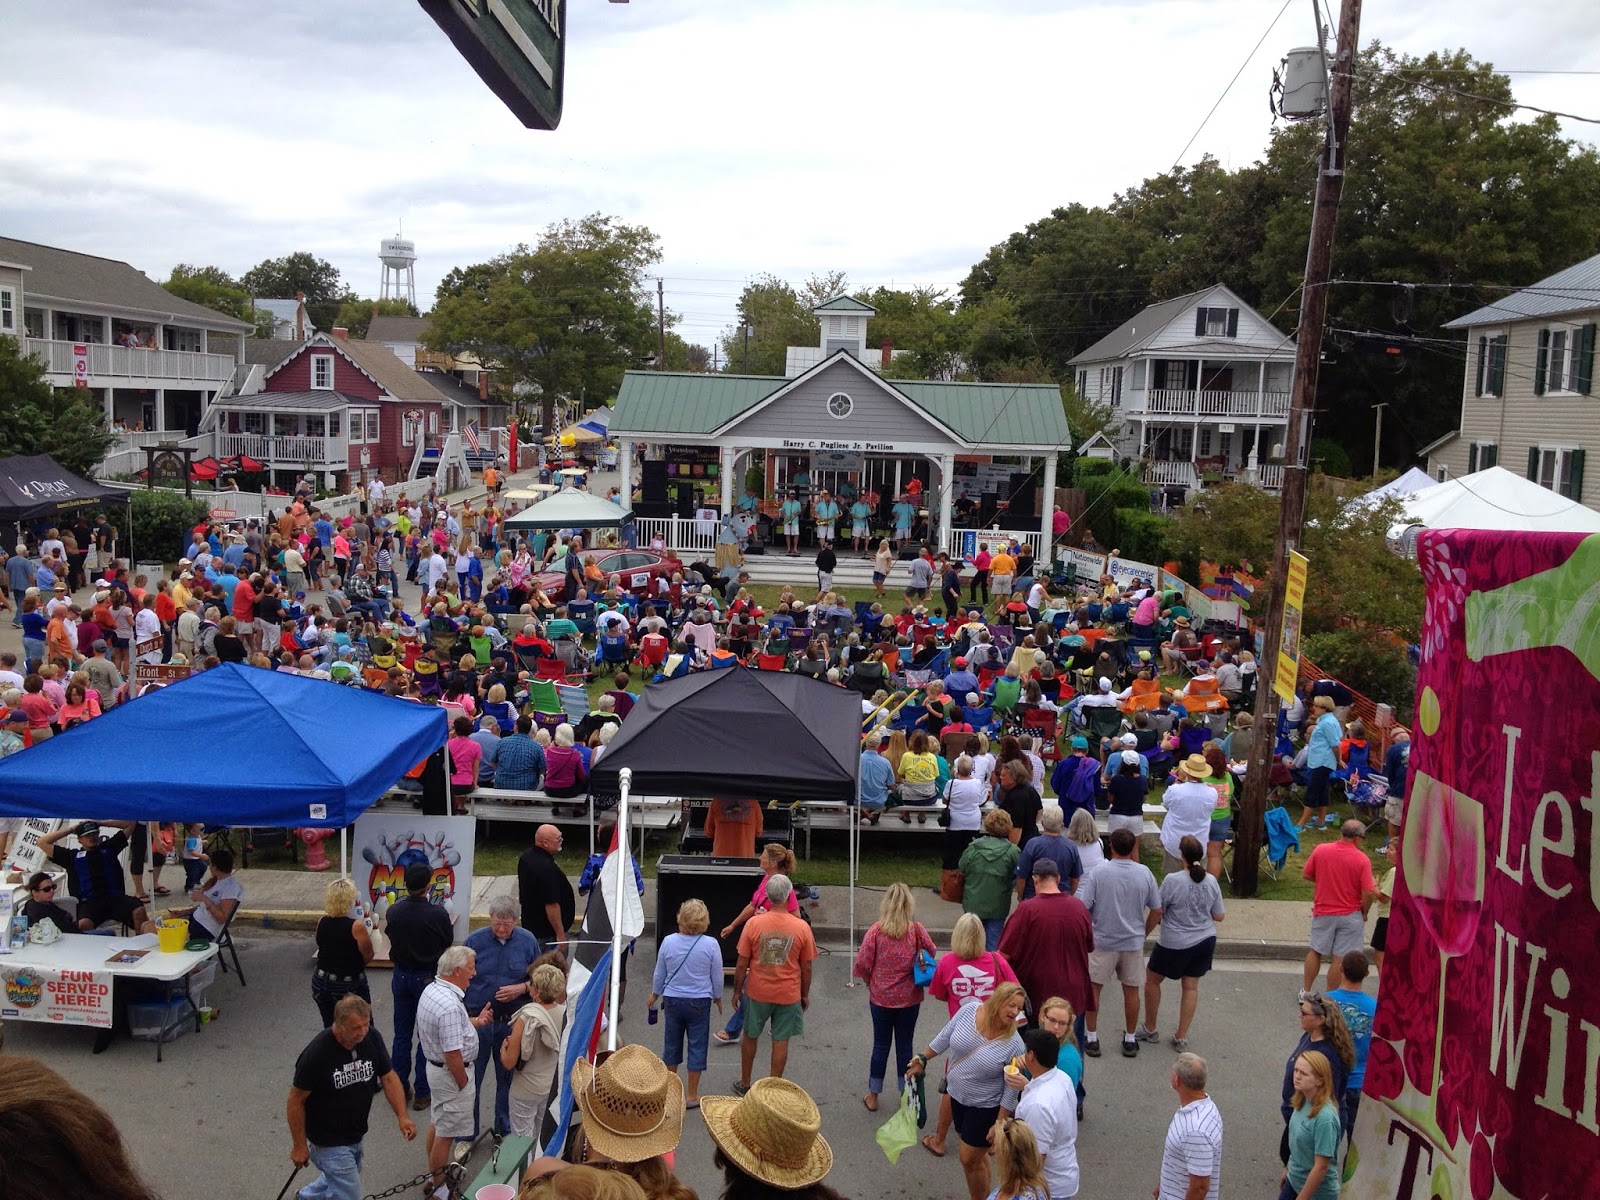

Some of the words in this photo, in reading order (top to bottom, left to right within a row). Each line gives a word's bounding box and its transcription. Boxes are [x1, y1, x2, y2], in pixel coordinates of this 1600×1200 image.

[783, 440, 804, 449] Harry
[820, 441, 849, 450] Pugliese
[866, 443, 894, 451] Pavilion
[213, 510, 236, 518] RESTROOMS
[1073, 551, 1102, 566] Nationwide
[140, 666, 159, 677] Front
[168, 669, 176, 678] St
[25, 817, 50, 834] PARKING
[22, 831, 41, 847] AFTE
[372, 865, 453, 890] MC
[61, 970, 93, 982] FUN
[7, 982, 41, 995] MAC
[47, 981, 109, 996] SERVED
[55, 994, 101, 1007] HERE!
